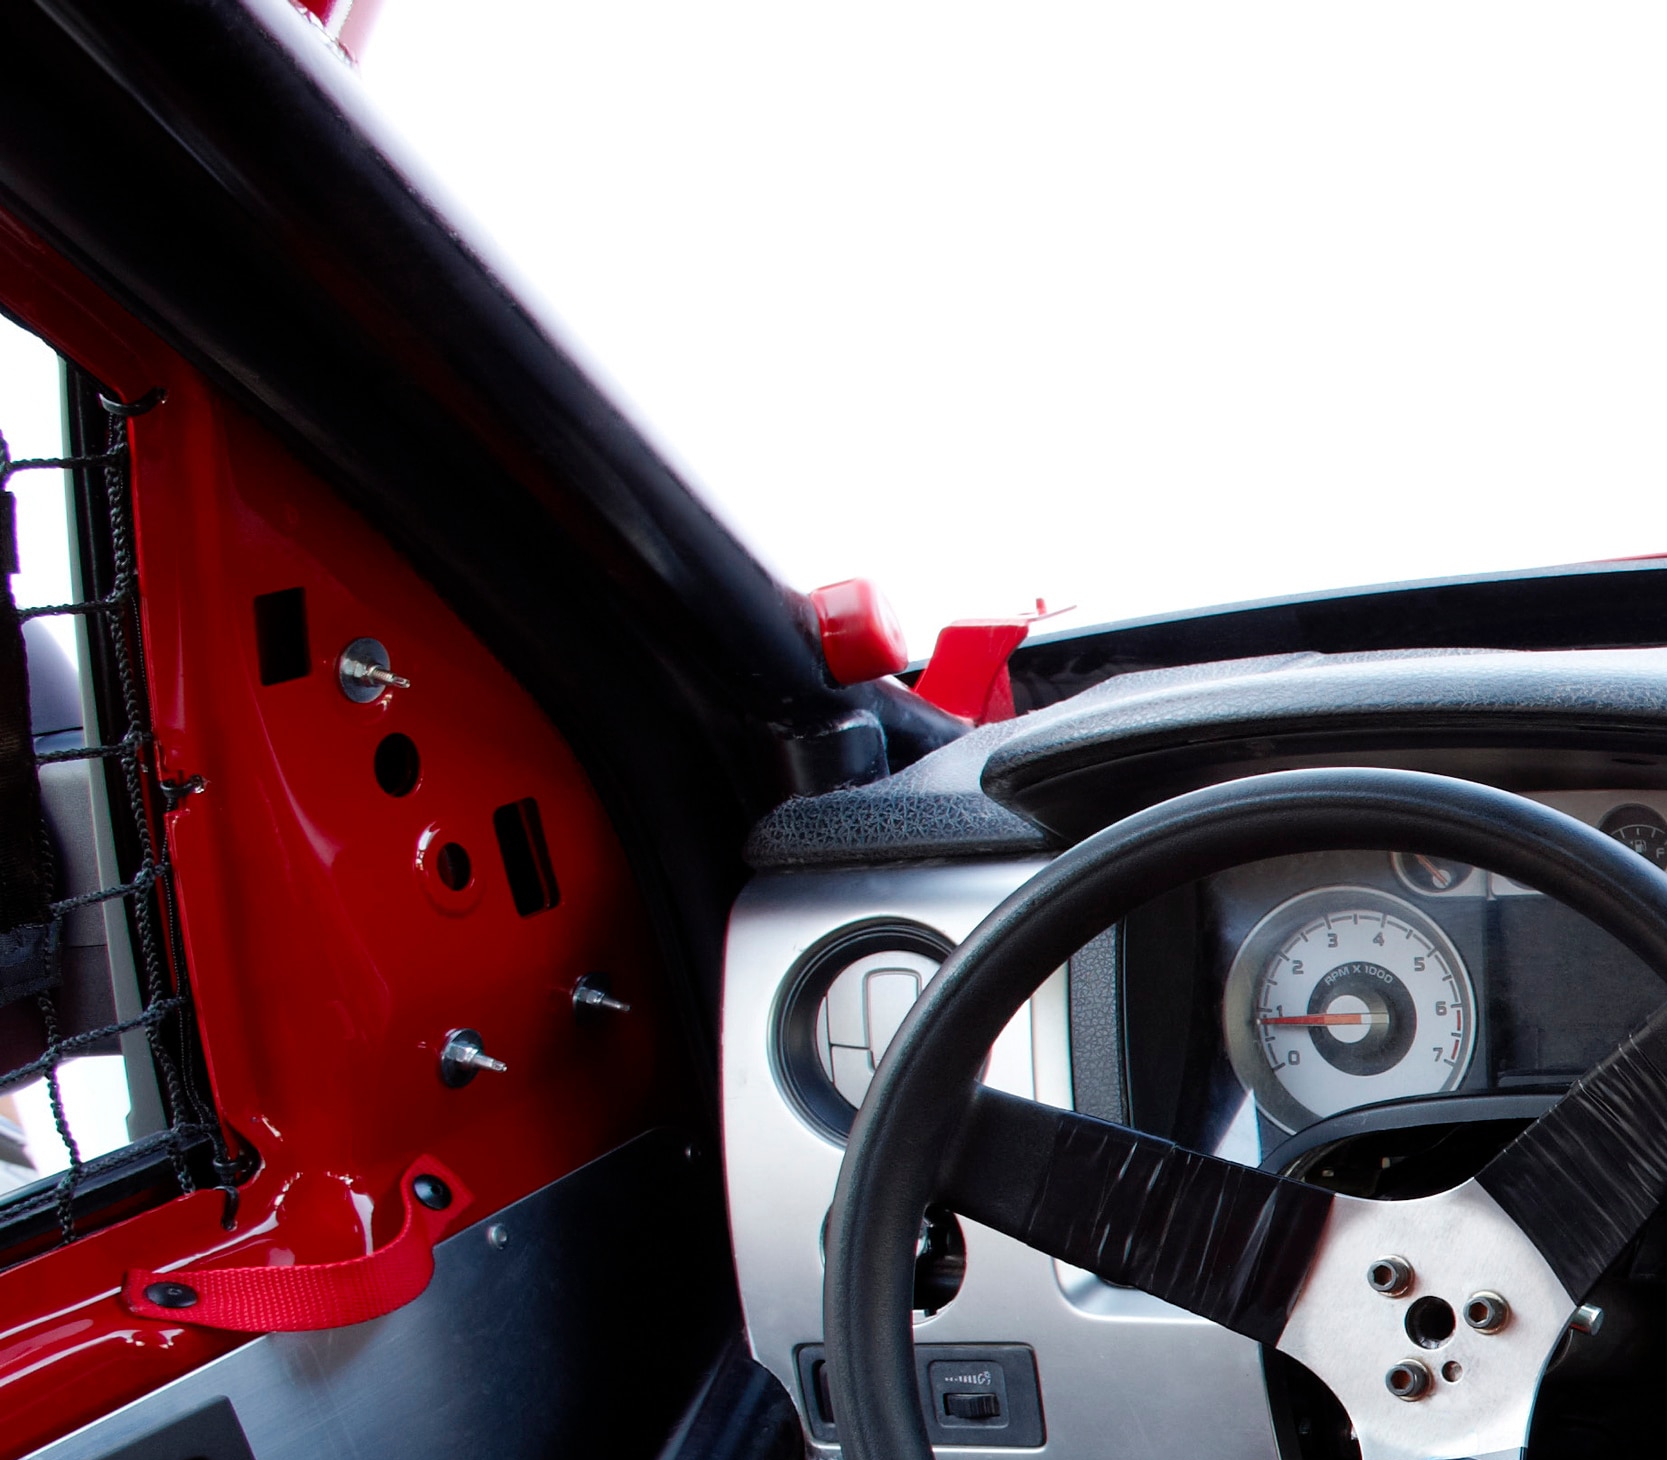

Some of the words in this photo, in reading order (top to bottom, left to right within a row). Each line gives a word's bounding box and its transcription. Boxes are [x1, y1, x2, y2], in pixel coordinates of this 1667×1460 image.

[1656, 847, 1665, 859] F
[1327, 933, 1339, 948] 3
[1372, 932, 1385, 947] 4
[1292, 960, 1304, 975] 2
[1414, 957, 1426, 972] 5
[1324, 966, 1349, 986] RPM
[1352, 964, 1361, 974] X
[1364, 966, 1393, 984] 1000
[1435, 1001, 1447, 1016] 6
[1288, 1050, 1300, 1065] 0
[1432, 1047, 1443, 1062] 7
